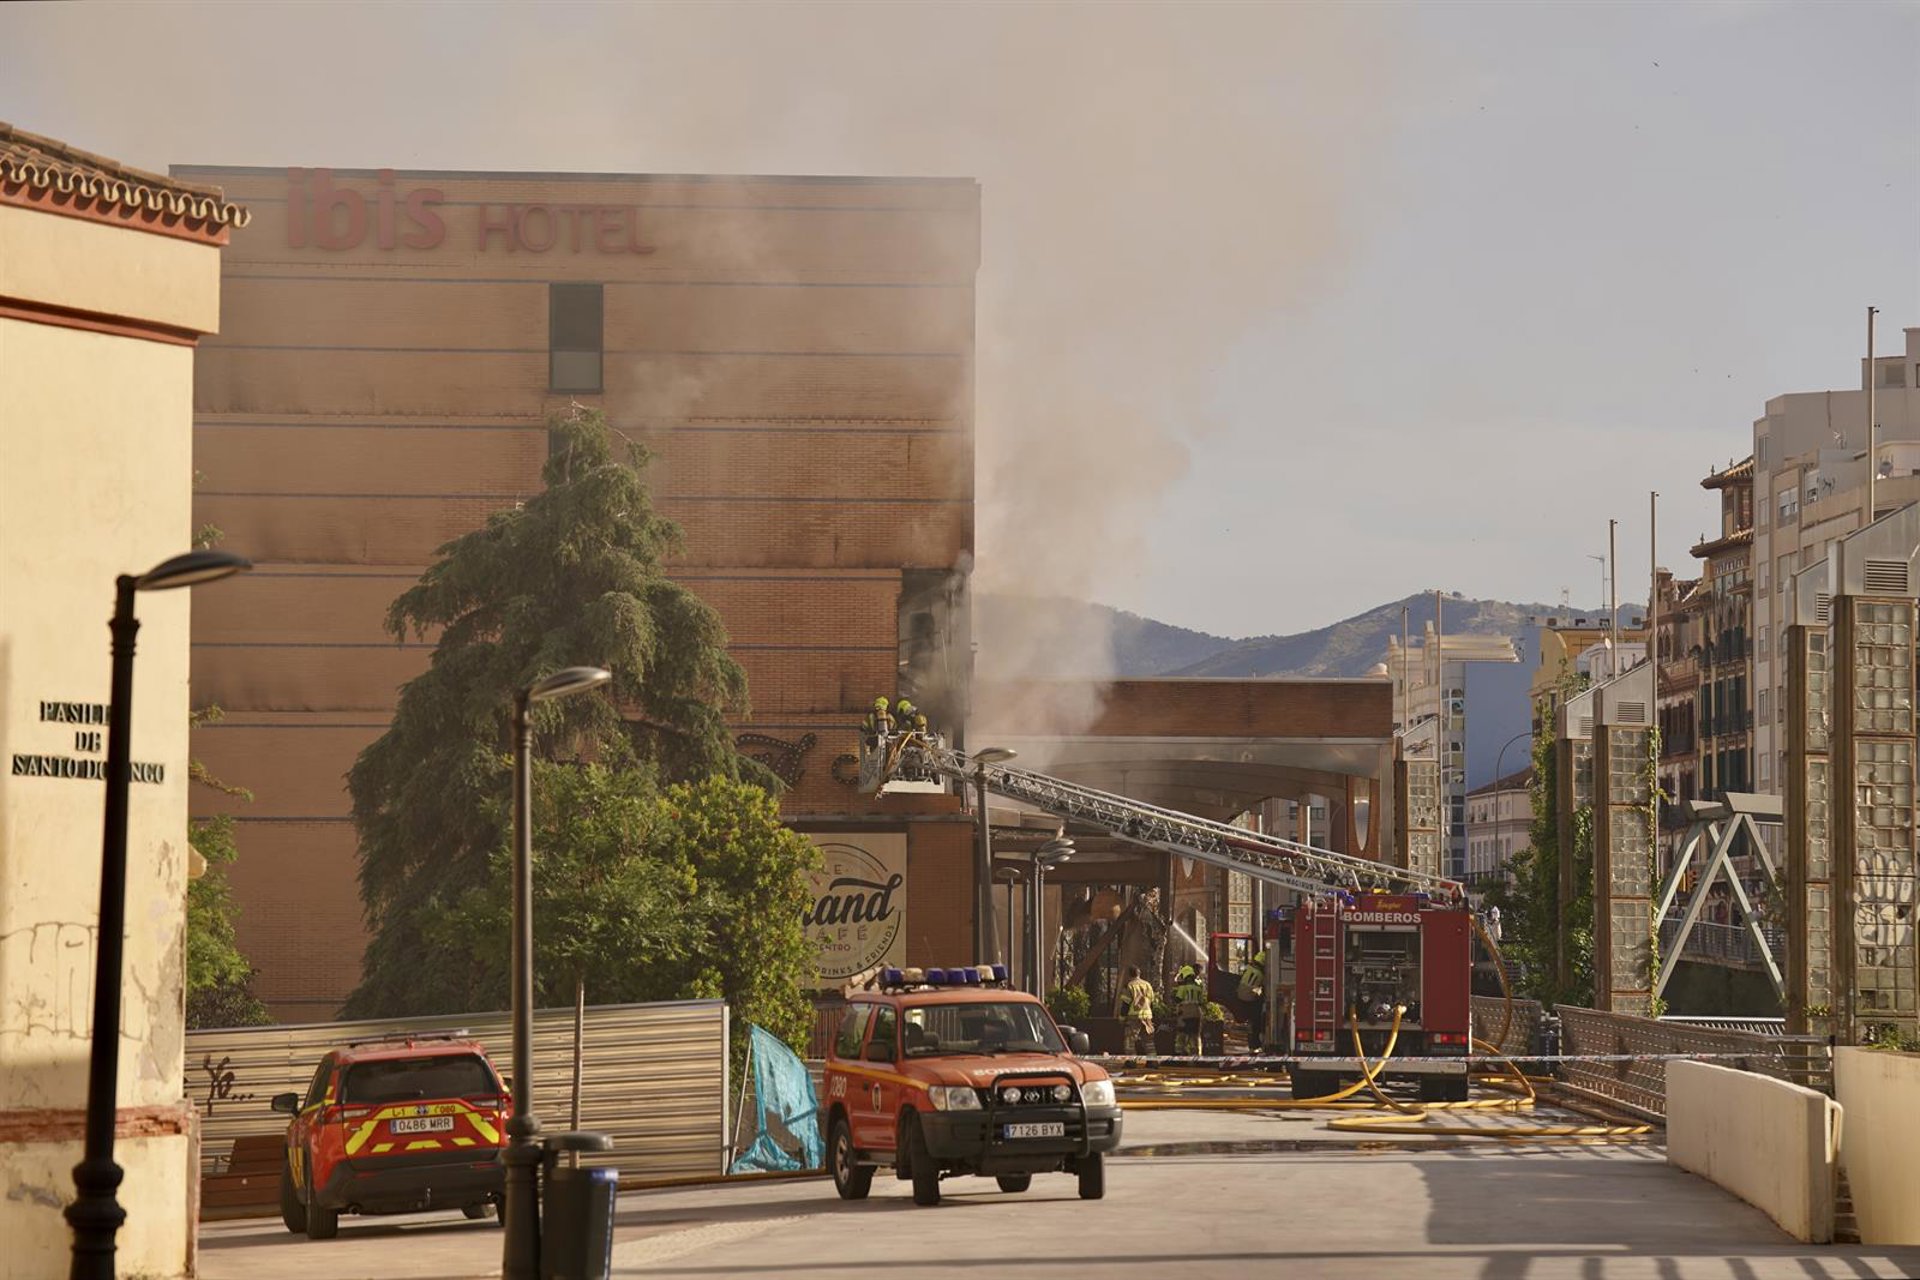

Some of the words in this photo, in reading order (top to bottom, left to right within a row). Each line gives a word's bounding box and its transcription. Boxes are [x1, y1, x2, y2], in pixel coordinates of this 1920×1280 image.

[287, 167, 446, 250] ibis
[479, 204, 656, 254] HOTEL
[40, 701, 111, 726] PASILL
[75, 732, 101, 752] DE
[12, 755, 80, 779] SANTO
[85, 759, 165, 784] DONGO
[1344, 912, 1421, 924] BOMBEROS
[856, 962, 864, 970] &
[864, 924, 895, 964] FRIENDS
[399, 1118, 427, 1131] 0486
[429, 1116, 451, 1129] MRR
[1011, 1125, 1038, 1137] 7126
[1041, 1124, 1063, 1136] BYX
